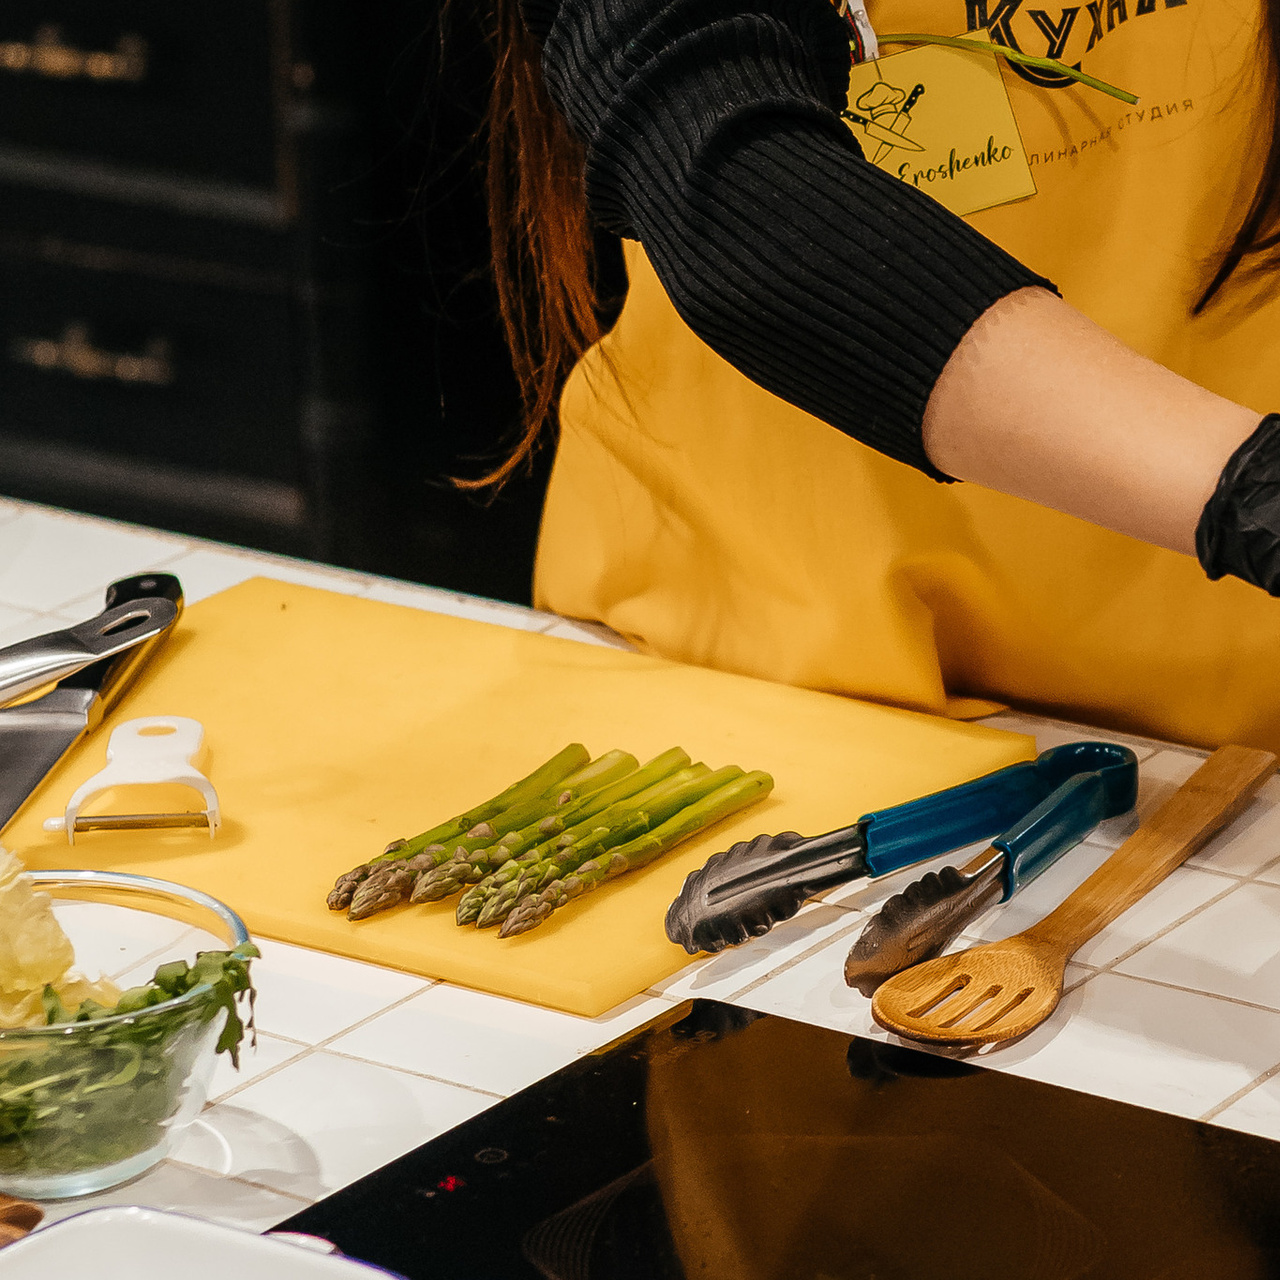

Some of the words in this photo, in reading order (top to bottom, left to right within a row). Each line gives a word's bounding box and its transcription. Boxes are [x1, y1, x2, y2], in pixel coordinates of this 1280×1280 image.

[897, 134, 1014, 187] Eroshenko
[1028, 126, 1113, 167] ЛИНАРНАЯ
[1117, 98, 1194, 131] СТУДИЯ
